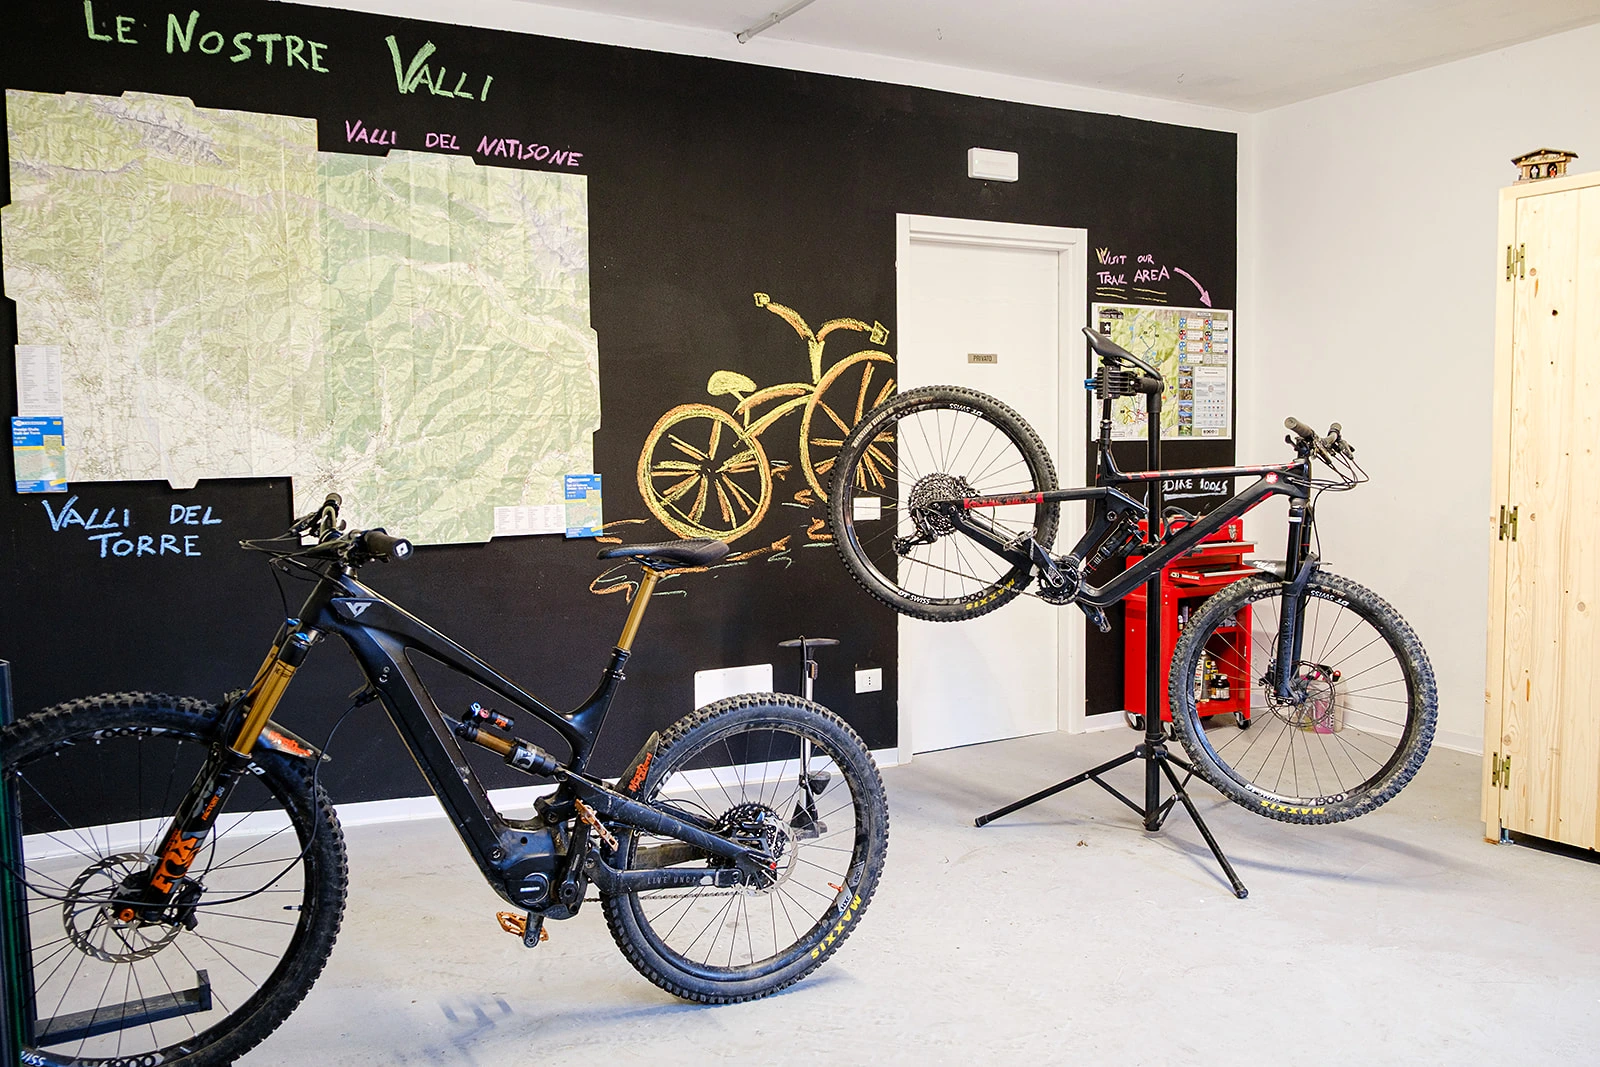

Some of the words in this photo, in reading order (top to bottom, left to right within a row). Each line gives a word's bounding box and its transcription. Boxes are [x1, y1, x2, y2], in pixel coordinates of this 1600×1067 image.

[84, 0, 138, 44] LE
[166, 10, 329, 73] NOSTRE
[385, 34, 493, 102] VALLI
[345, 119, 396, 145] VALLI
[425, 132, 460, 150] DEL
[476, 135, 583, 167] NATISONE
[1095, 247, 1127, 265] VISIT
[1137, 254, 1155, 265] OUR
[1096, 271, 1128, 286] TRAIL
[1133, 265, 1170, 283] AREA
[972, 353, 993, 362] PRIVATO
[41, 495, 130, 532] VALLI
[170, 504, 222, 525] DEL
[88, 532, 201, 558] TORRE
[964, 578, 1015, 611] MAXXIS
[1310, 590, 1335, 601] SWISS
[1260, 800, 1325, 815] MAXXIS
[810, 894, 862, 960] MAXXIS
